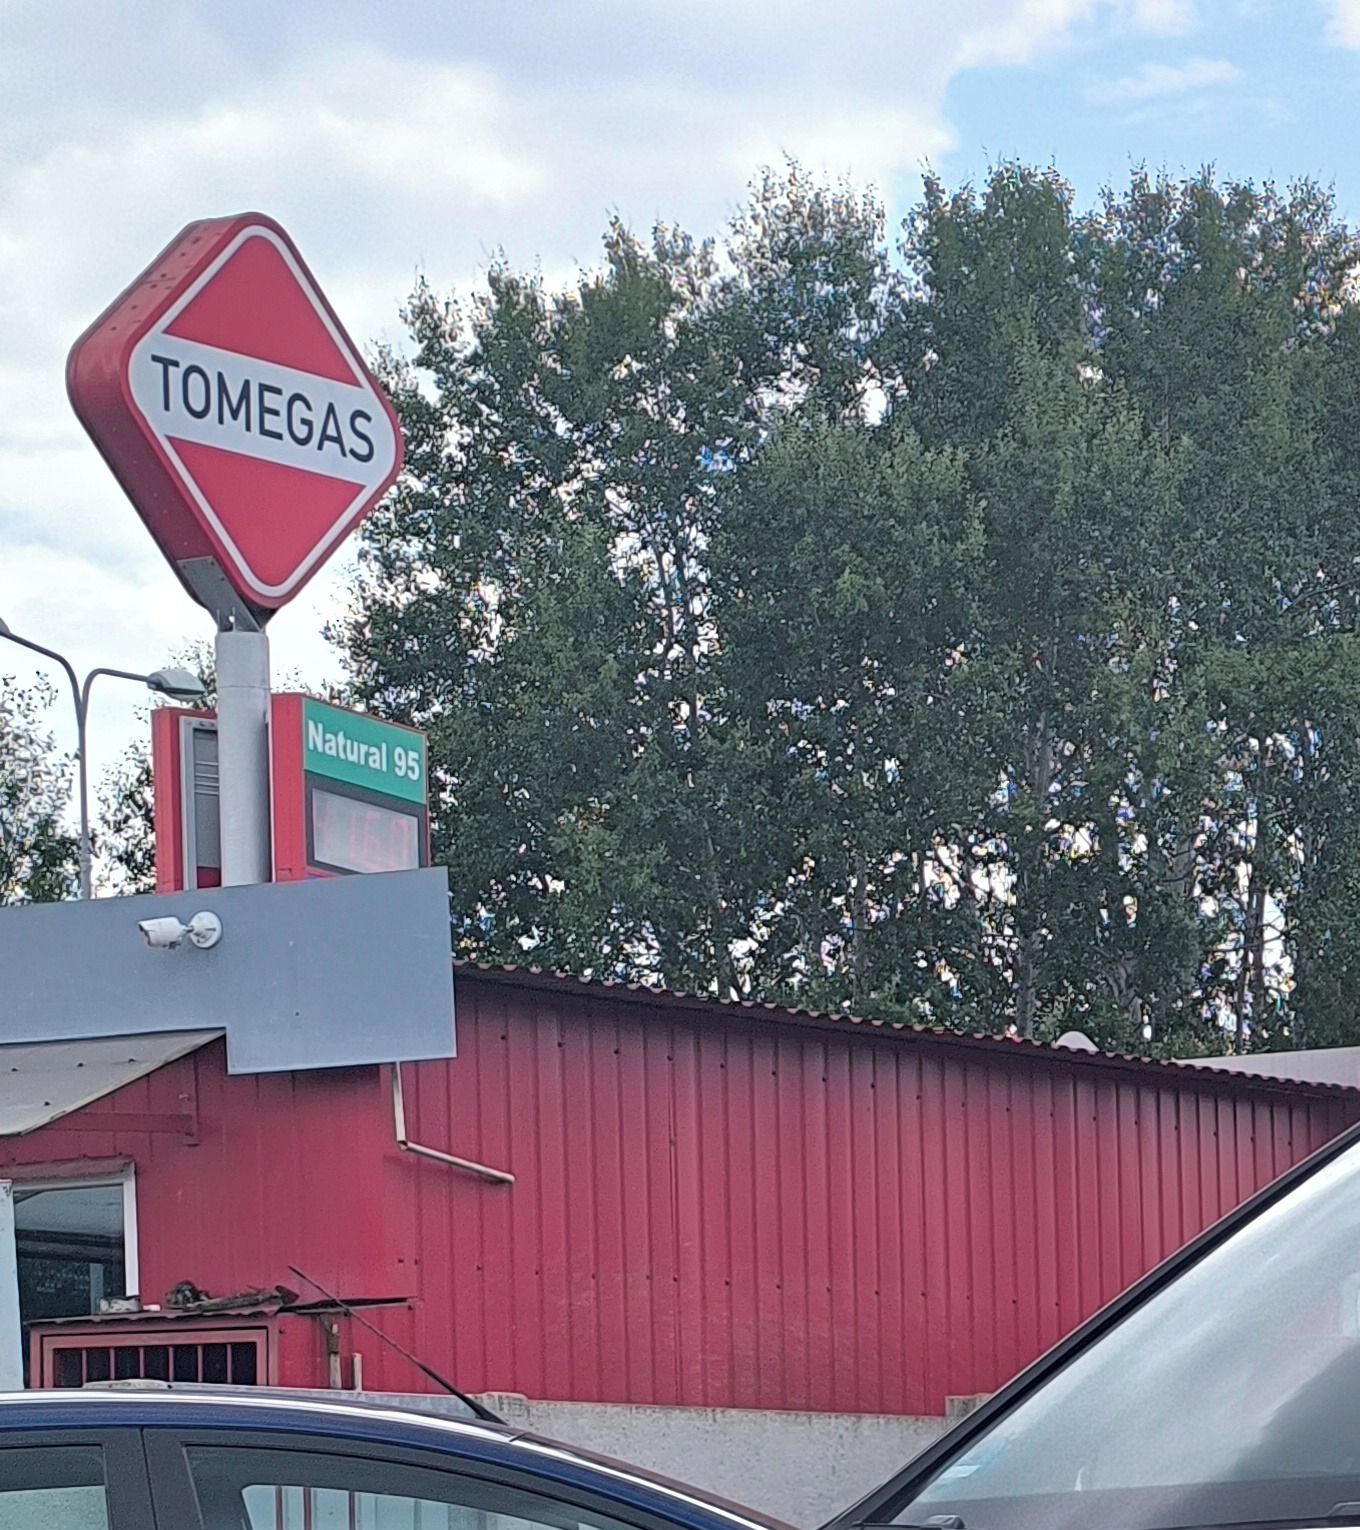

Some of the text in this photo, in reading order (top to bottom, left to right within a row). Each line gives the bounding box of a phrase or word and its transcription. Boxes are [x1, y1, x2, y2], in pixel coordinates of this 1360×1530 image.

[150, 354, 376, 464] TOMEGAS
[307, 720, 421, 781] Natural 95
